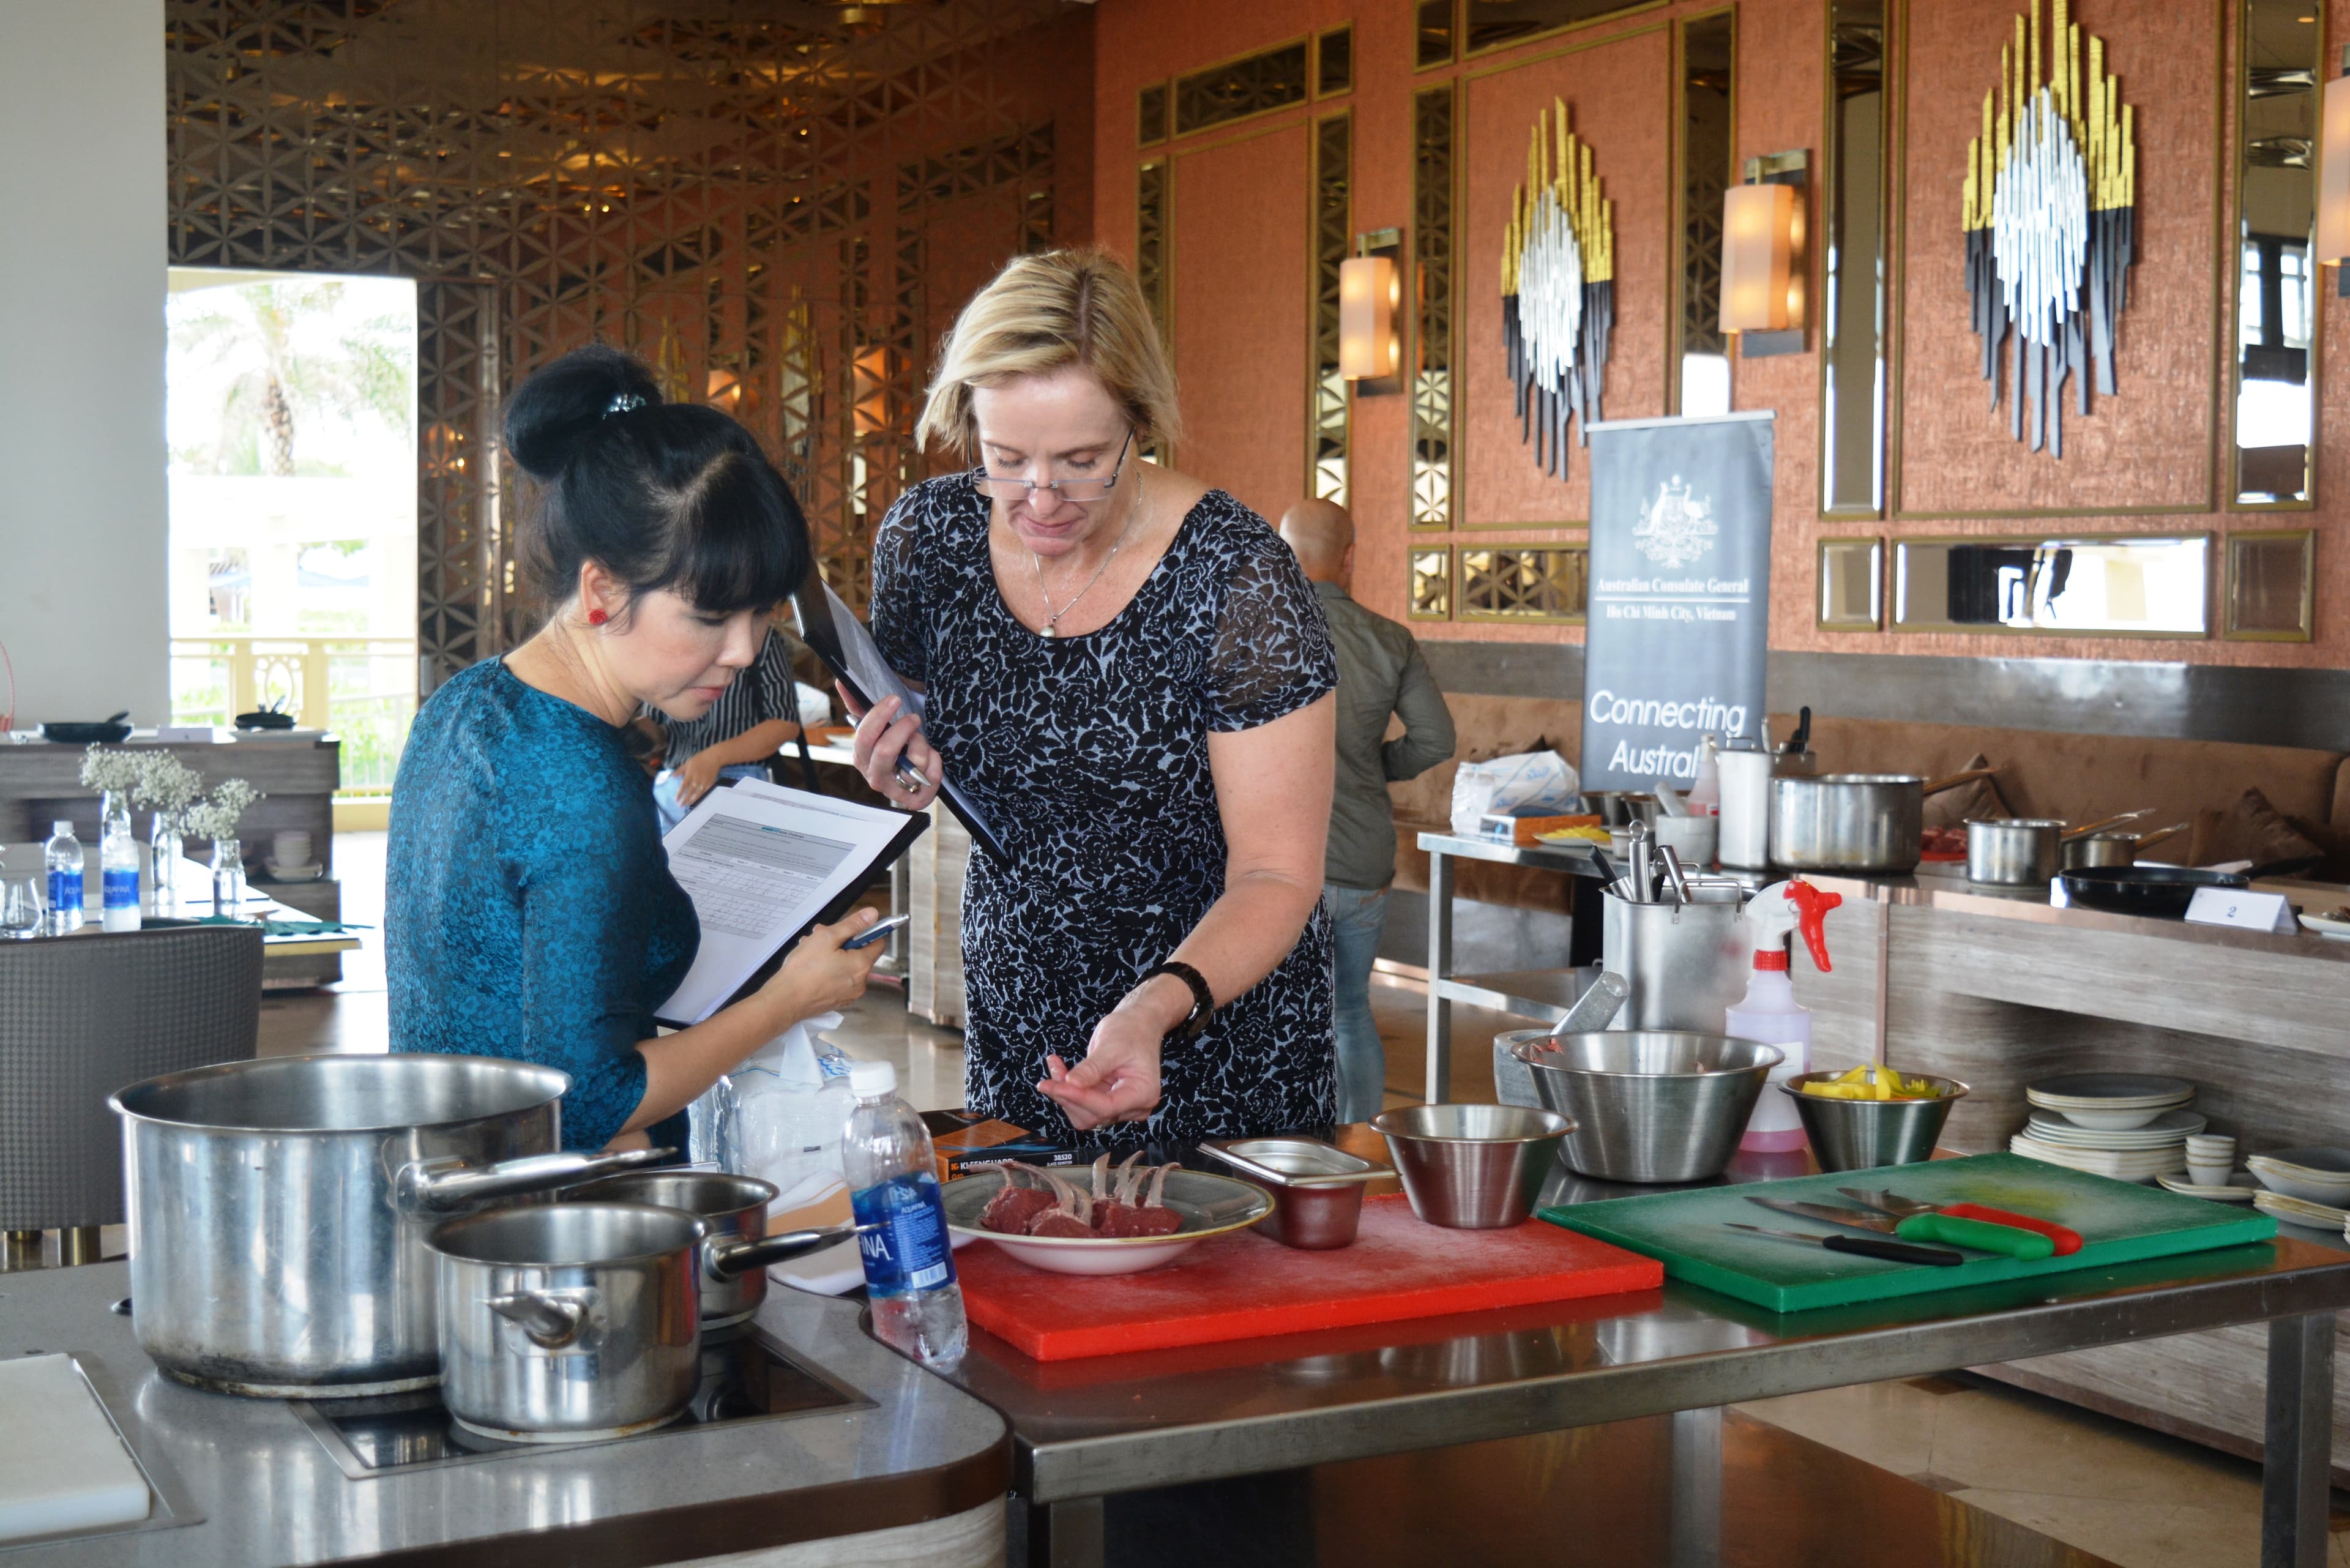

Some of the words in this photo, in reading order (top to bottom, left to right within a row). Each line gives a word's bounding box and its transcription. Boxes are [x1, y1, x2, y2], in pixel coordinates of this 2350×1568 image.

[1595, 577, 1650, 592] Australian
[1652, 577, 1704, 593] Consulate
[1707, 577, 1749, 593] General
[1606, 605, 1622, 619] Ho
[1623, 605, 1640, 619] Chi
[1643, 605, 1668, 619] Minh
[1696, 606, 1736, 621] Vietnam
[1589, 689, 1747, 738] Connecting
[1608, 739, 1701, 778] Austral
[2227, 906, 2237, 918] 2
